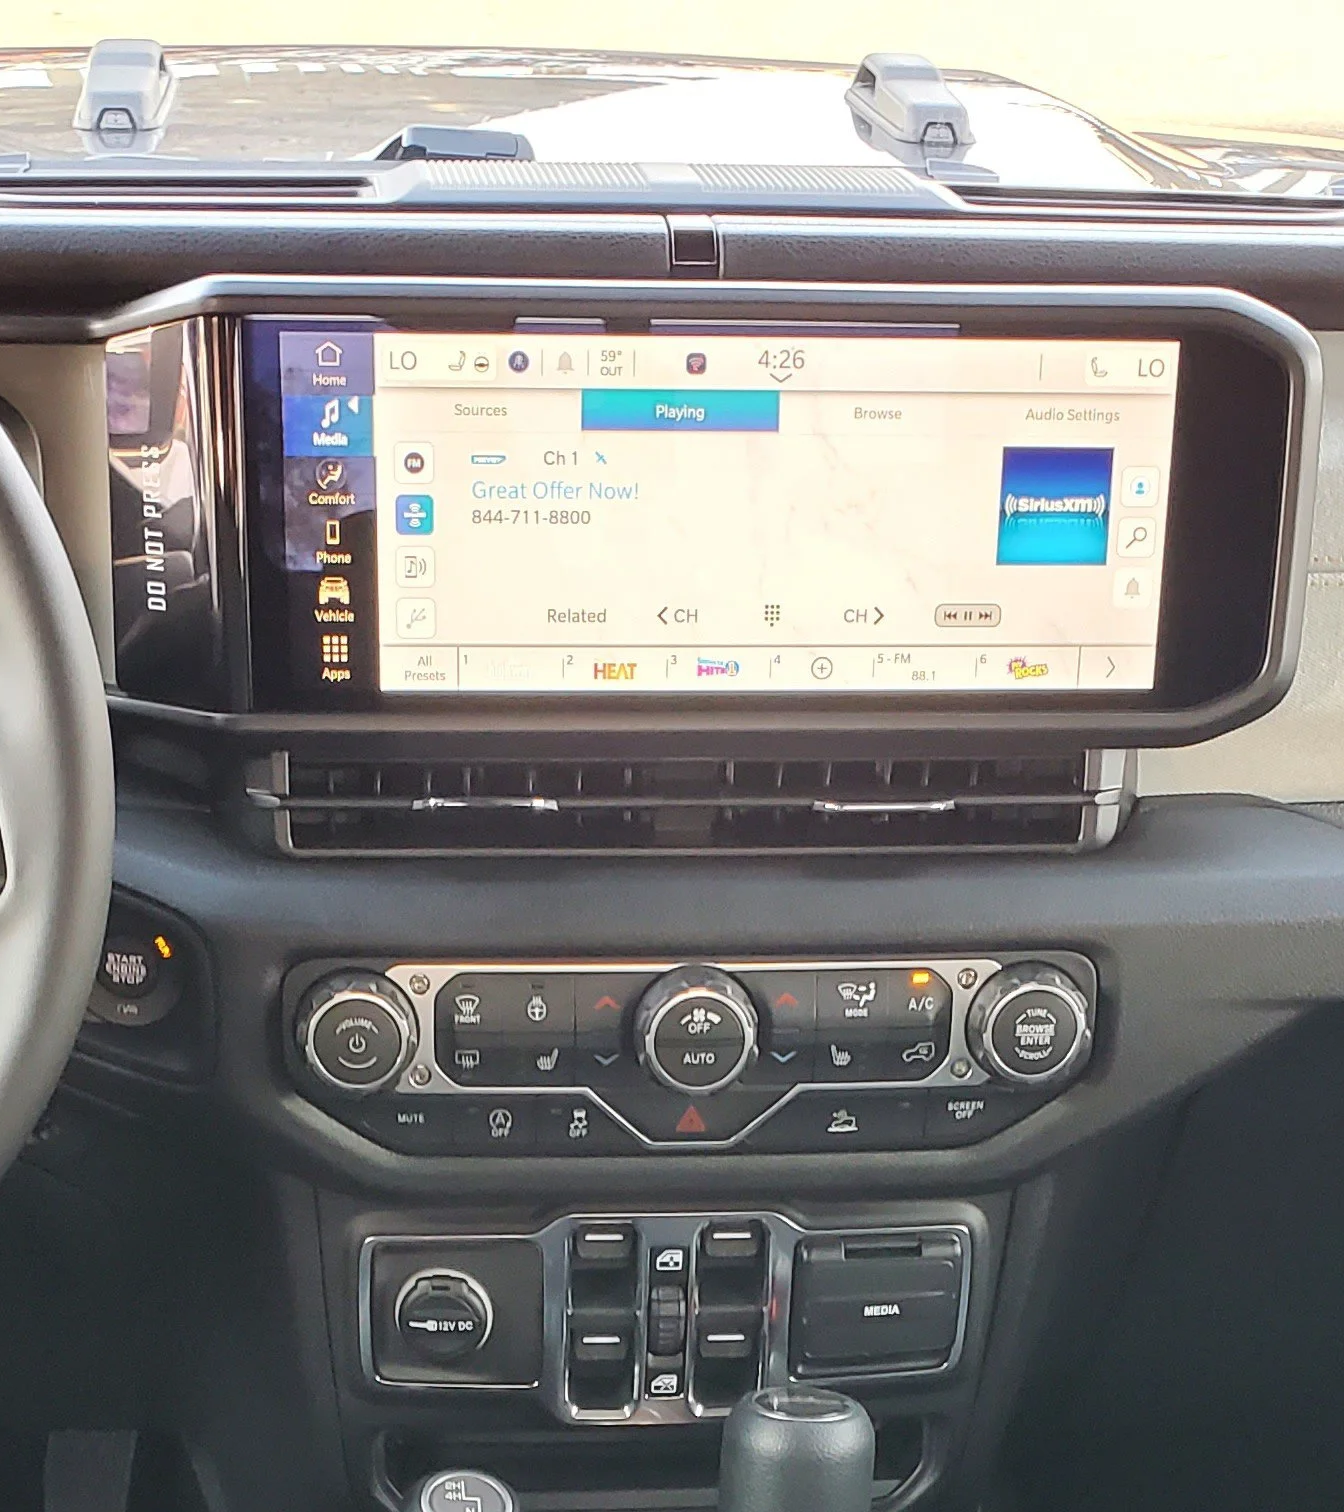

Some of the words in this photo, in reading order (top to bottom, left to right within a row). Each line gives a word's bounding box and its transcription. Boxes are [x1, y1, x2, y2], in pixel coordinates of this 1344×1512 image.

[389, 352, 417, 371] LO
[600, 350, 623, 363] 59°
[758, 349, 806, 370] 4:26
[599, 365, 623, 377] OUT
[1138, 359, 1165, 377] LO
[312, 373, 347, 387] Home
[454, 403, 508, 418] Sources
[655, 404, 706, 422] Playing
[854, 406, 903, 421] Browse
[1025, 408, 1065, 422] Audio
[1066, 408, 1121, 424] Settings
[312, 432, 349, 447] Media
[406, 458, 422, 470] FM
[543, 451, 566, 466] Ch
[141, 444, 163, 519] PRESS
[471, 481, 527, 500] Great
[533, 481, 583, 500] Offer
[589, 482, 639, 500] Now!
[308, 491, 355, 506] Comfort
[471, 509, 591, 525] 844-711-8800
[144, 526, 166, 572] NOT
[316, 551, 351, 566] Phone
[148, 580, 167, 612] DO
[314, 608, 354, 623] Vehicle
[547, 608, 607, 624] Related
[674, 609, 699, 623] CH
[844, 609, 868, 623] CH
[417, 656, 432, 666] All
[566, 655, 574, 665] 2
[670, 655, 678, 665] 3
[877, 653, 884, 664] 5
[894, 653, 911, 664] FM
[980, 654, 987, 664] 6
[321, 667, 351, 683] Apps
[404, 670, 446, 681] Presets
[593, 662, 637, 680] HEAT
[107, 952, 143, 962] START
[908, 998, 934, 1013] A/C
[845, 1008, 868, 1018] MODE
[1026, 1008, 1047, 1018] TUNE
[341, 1017, 373, 1030] VOLUME
[455, 1015, 481, 1025] FRONT
[688, 1022, 711, 1035] OFF
[1016, 1024, 1055, 1034] BROWSE
[1020, 1036, 1051, 1046] ENTER
[683, 1052, 715, 1066] AUTO
[947, 1100, 985, 1112] SCREEN
[397, 1112, 425, 1125] MUTE
[955, 1109, 974, 1121] OFF
[491, 1126, 510, 1138] OFF
[568, 1127, 588, 1139] OFF
[863, 1304, 900, 1317] MEDIA
[438, 1320, 456, 1332] 12V
[457, 1320, 474, 1331] DC
[444, 1491, 462, 1501] 4H
